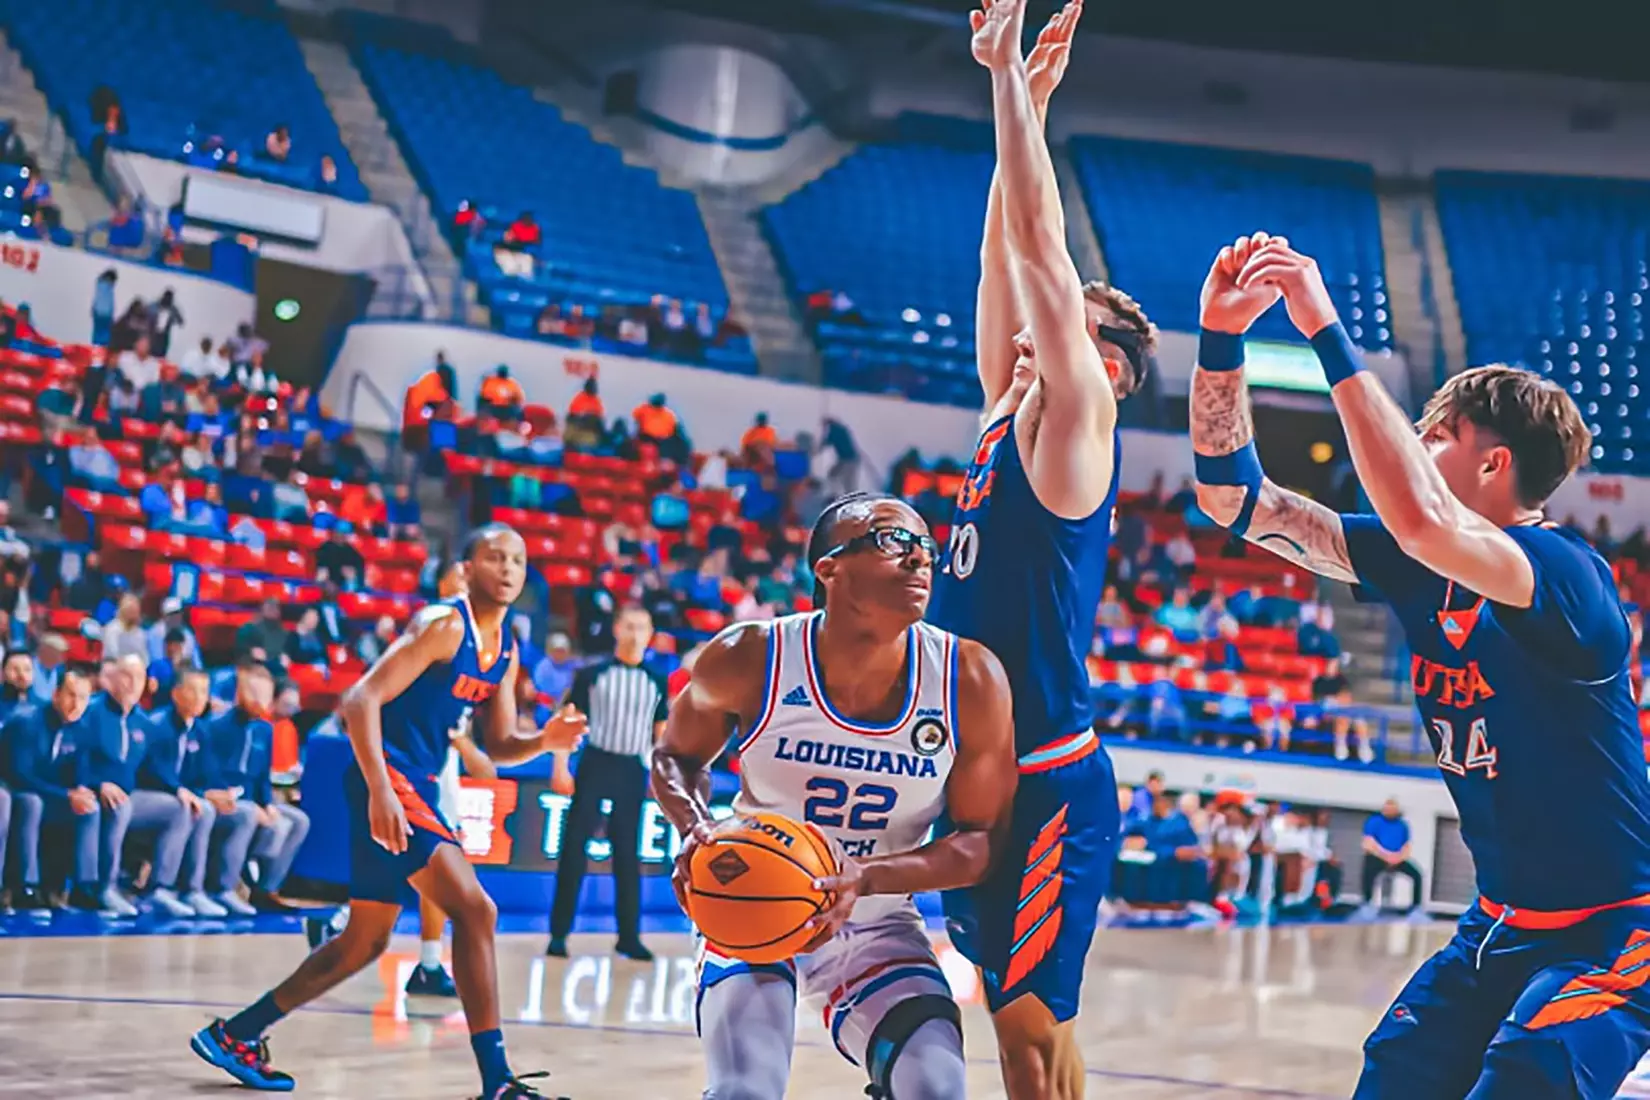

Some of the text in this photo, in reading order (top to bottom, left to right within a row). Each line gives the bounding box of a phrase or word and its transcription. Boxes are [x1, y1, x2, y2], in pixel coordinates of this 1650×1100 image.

[1411, 653, 1496, 709] UTSA
[774, 737, 938, 778] LOUISIANA
[804, 776, 899, 831] 22
[836, 837, 877, 858] CH
